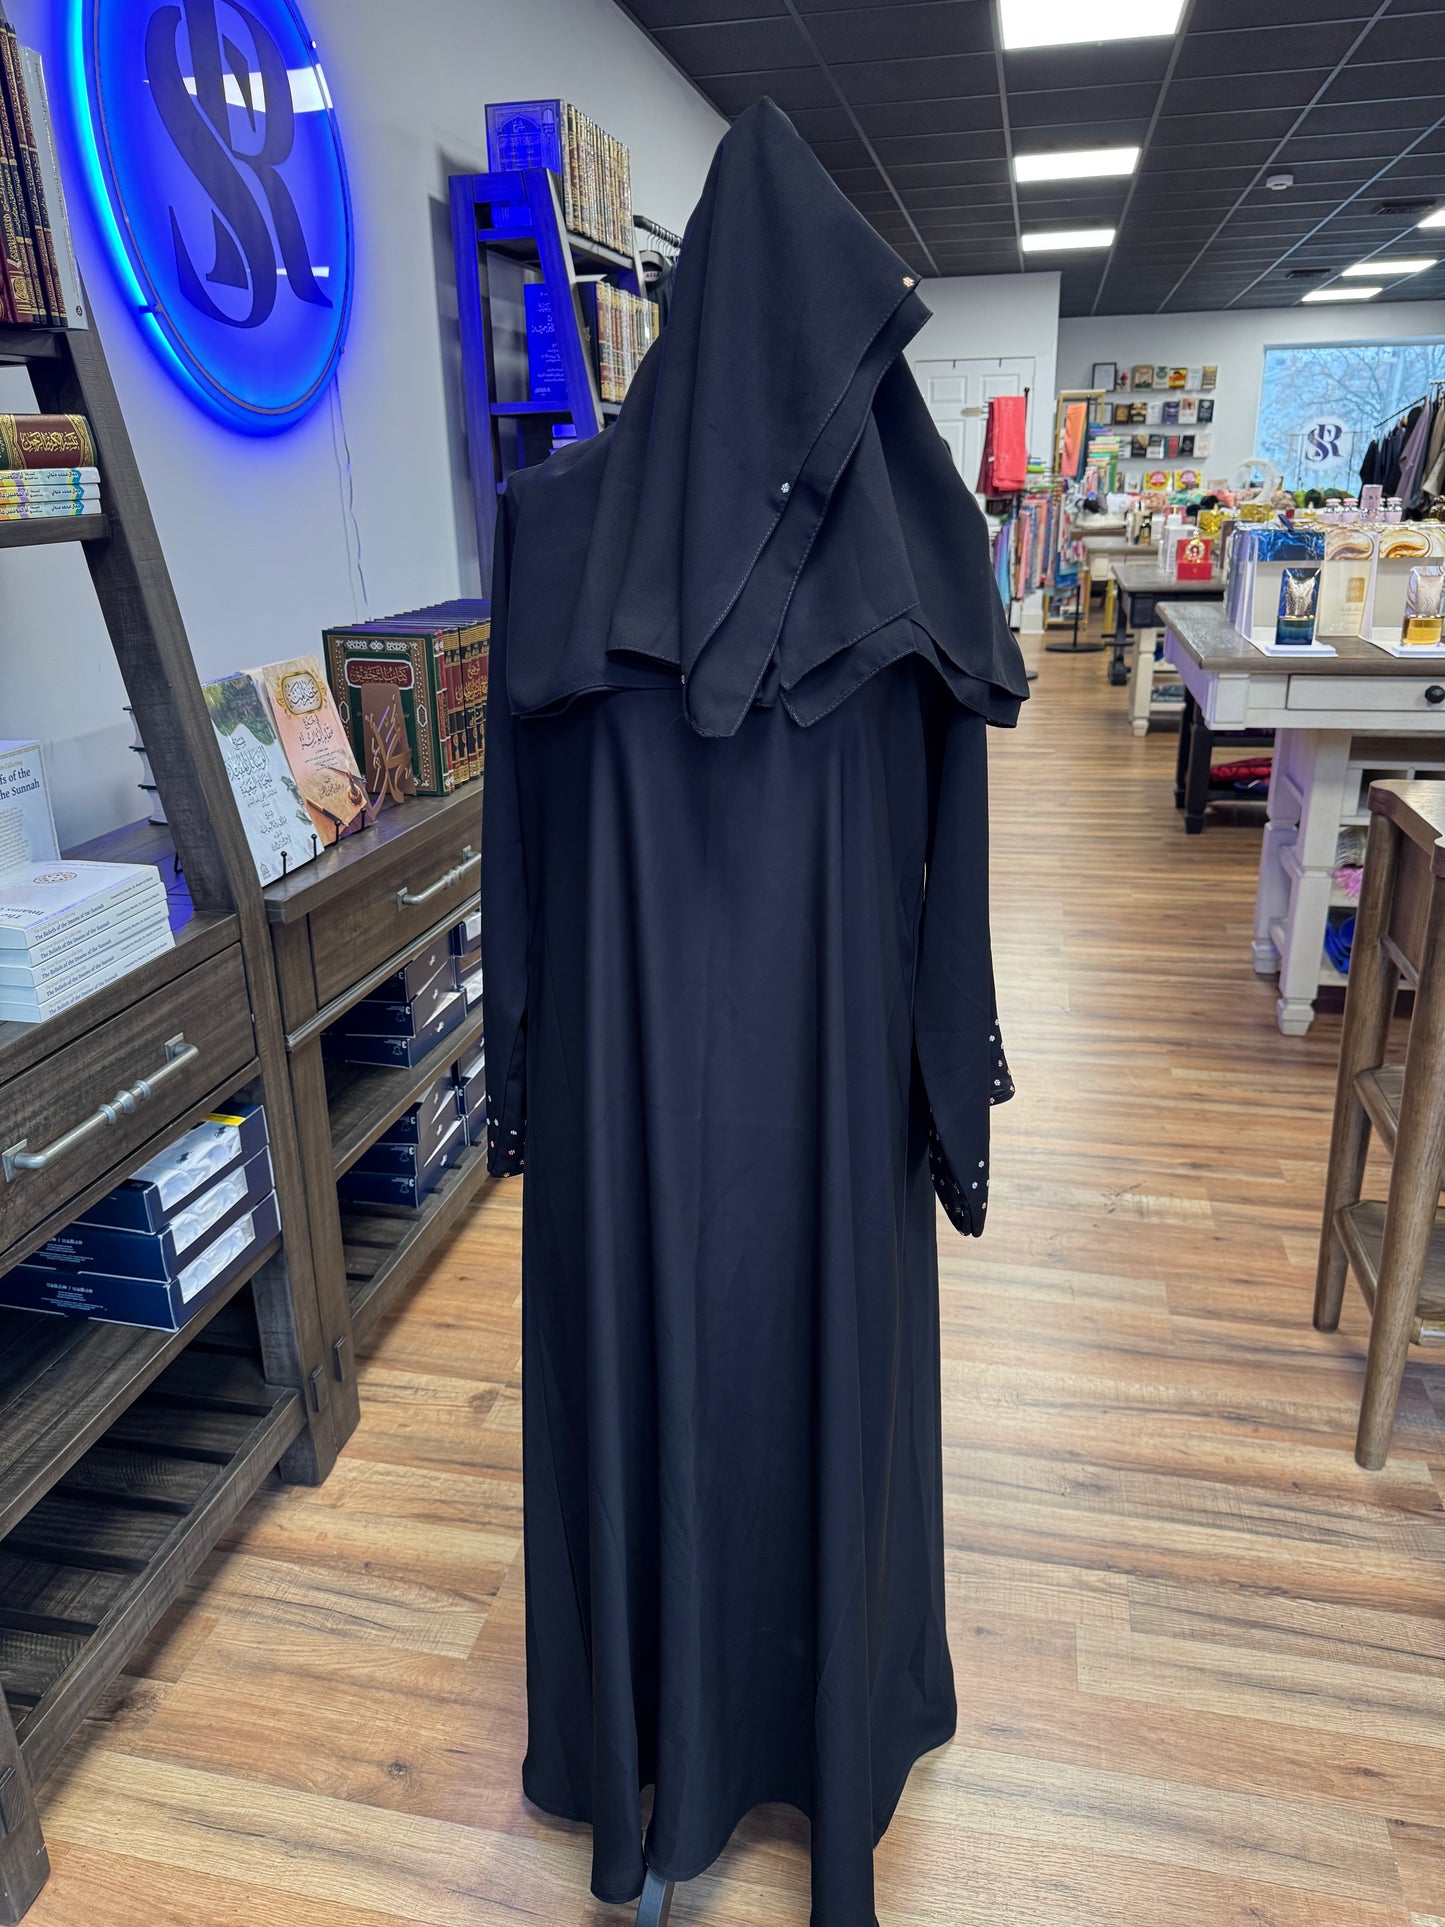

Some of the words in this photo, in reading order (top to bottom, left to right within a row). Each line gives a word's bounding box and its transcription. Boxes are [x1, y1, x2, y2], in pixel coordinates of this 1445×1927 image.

[20, 431, 46, 452] الرحمن
[44, 431, 63, 452] الكريم
[62, 431, 80, 452] تيسير
[350, 666, 383, 682] التحقيق
[383, 666, 408, 684] كتاب
[231, 736, 246, 750] شرح
[9, 770, 17, 782] of
[18, 768, 31, 779] the
[0, 789, 10, 800] he
[12, 778, 40, 796] Sunnah
[43, 926, 56, 936] Beliefs
[67, 914, 79, 924] Imams
[90, 903, 104, 913] Sunnah
[48, 944, 61, 954] Beliefs
[72, 932, 85, 942] Imams
[96, 919, 109, 930] Sunnah
[50, 963, 63, 974] Beliefs
[74, 950, 87, 961] Imams
[97, 938, 111, 949] Sunnah
[54, 981, 67, 992] Beliefs
[78, 968, 90, 979] Imams
[101, 955, 114, 966] Sunnah
